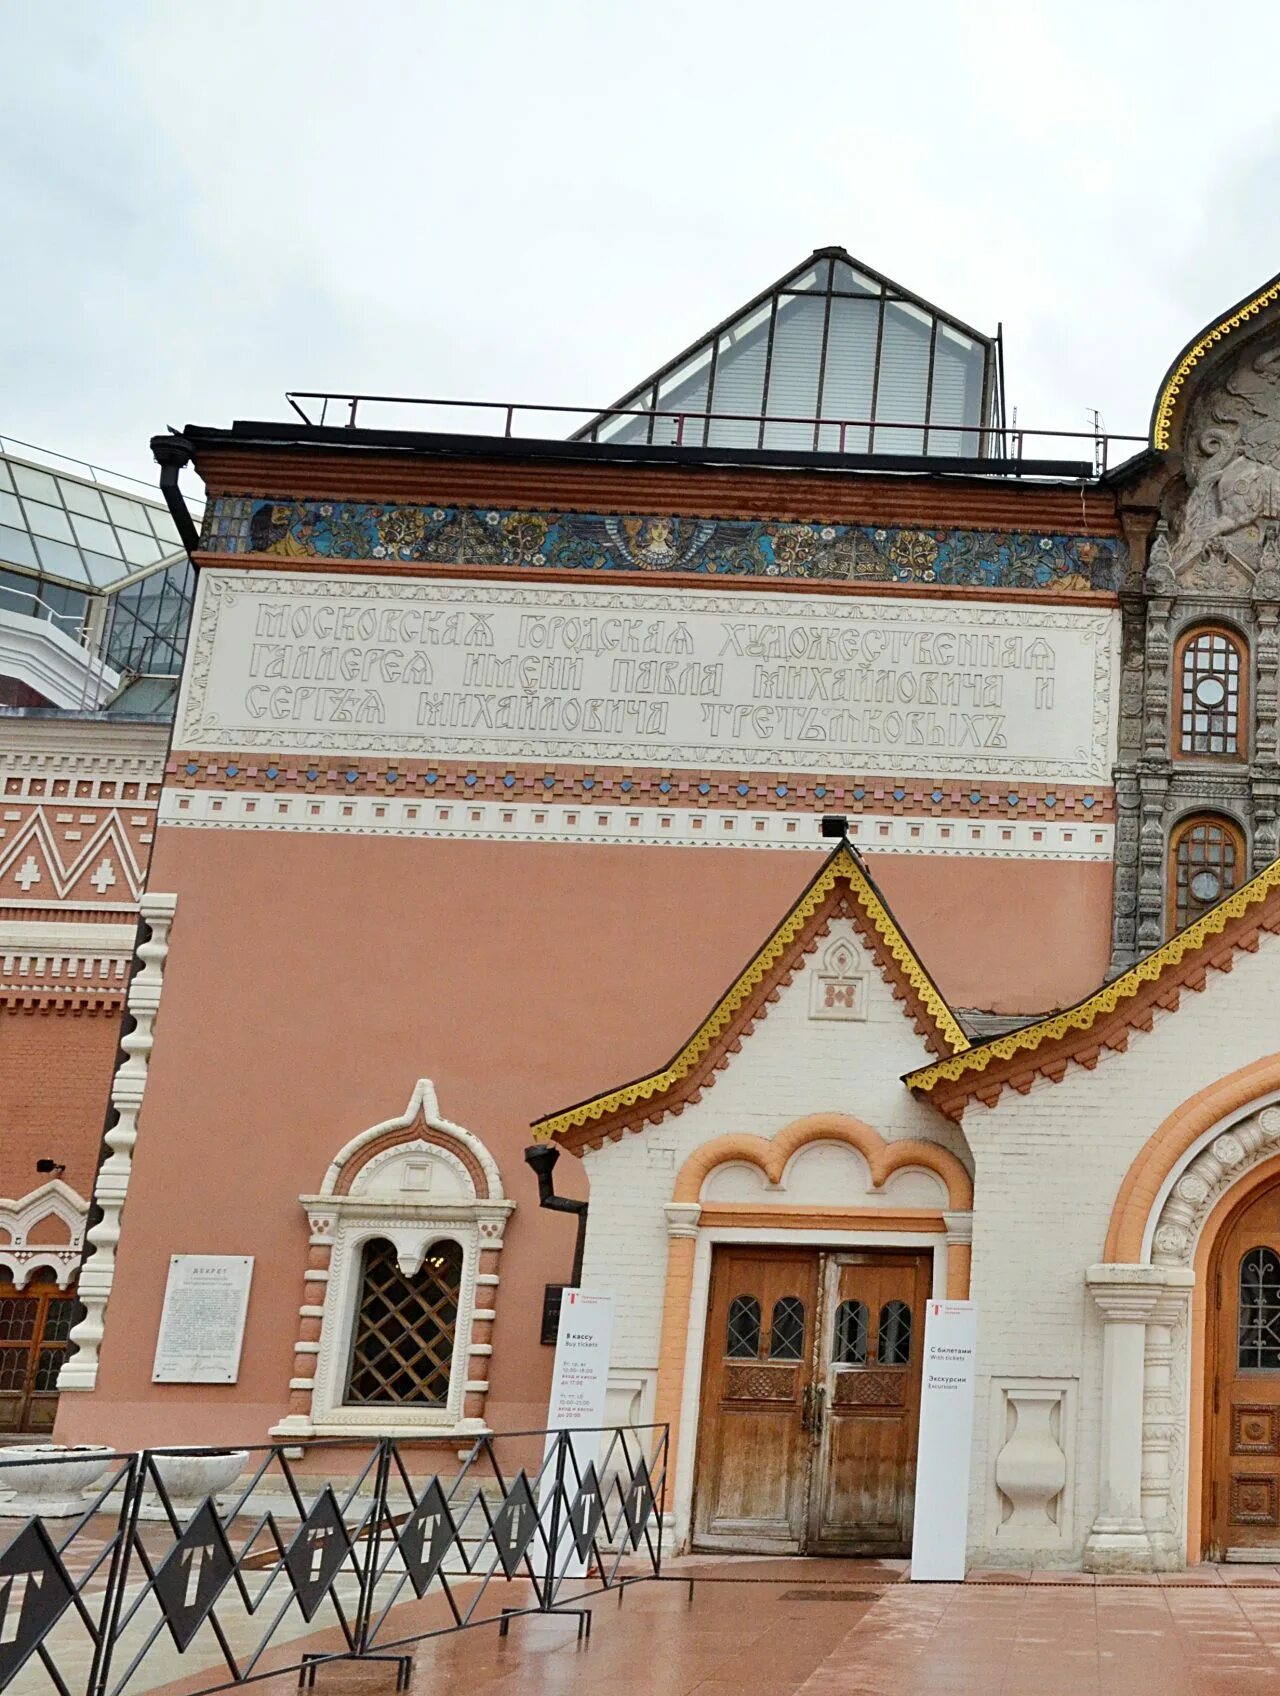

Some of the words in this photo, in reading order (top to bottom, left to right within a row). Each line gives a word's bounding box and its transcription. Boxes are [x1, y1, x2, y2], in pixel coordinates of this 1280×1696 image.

[462, 652, 584, 691] ИМЕНИ
[610, 657, 723, 697] ПАВЛА
[753, 663, 1004, 709] МИХАЙЛОВИЧА
[1034, 676, 1055, 710] И
[416, 689, 669, 735] МИХАЙЛОВИЧА
[572, 1333, 594, 1341] кассу
[936, 1346, 972, 1354] билетами
[928, 1375, 967, 1383] Экскурсии
